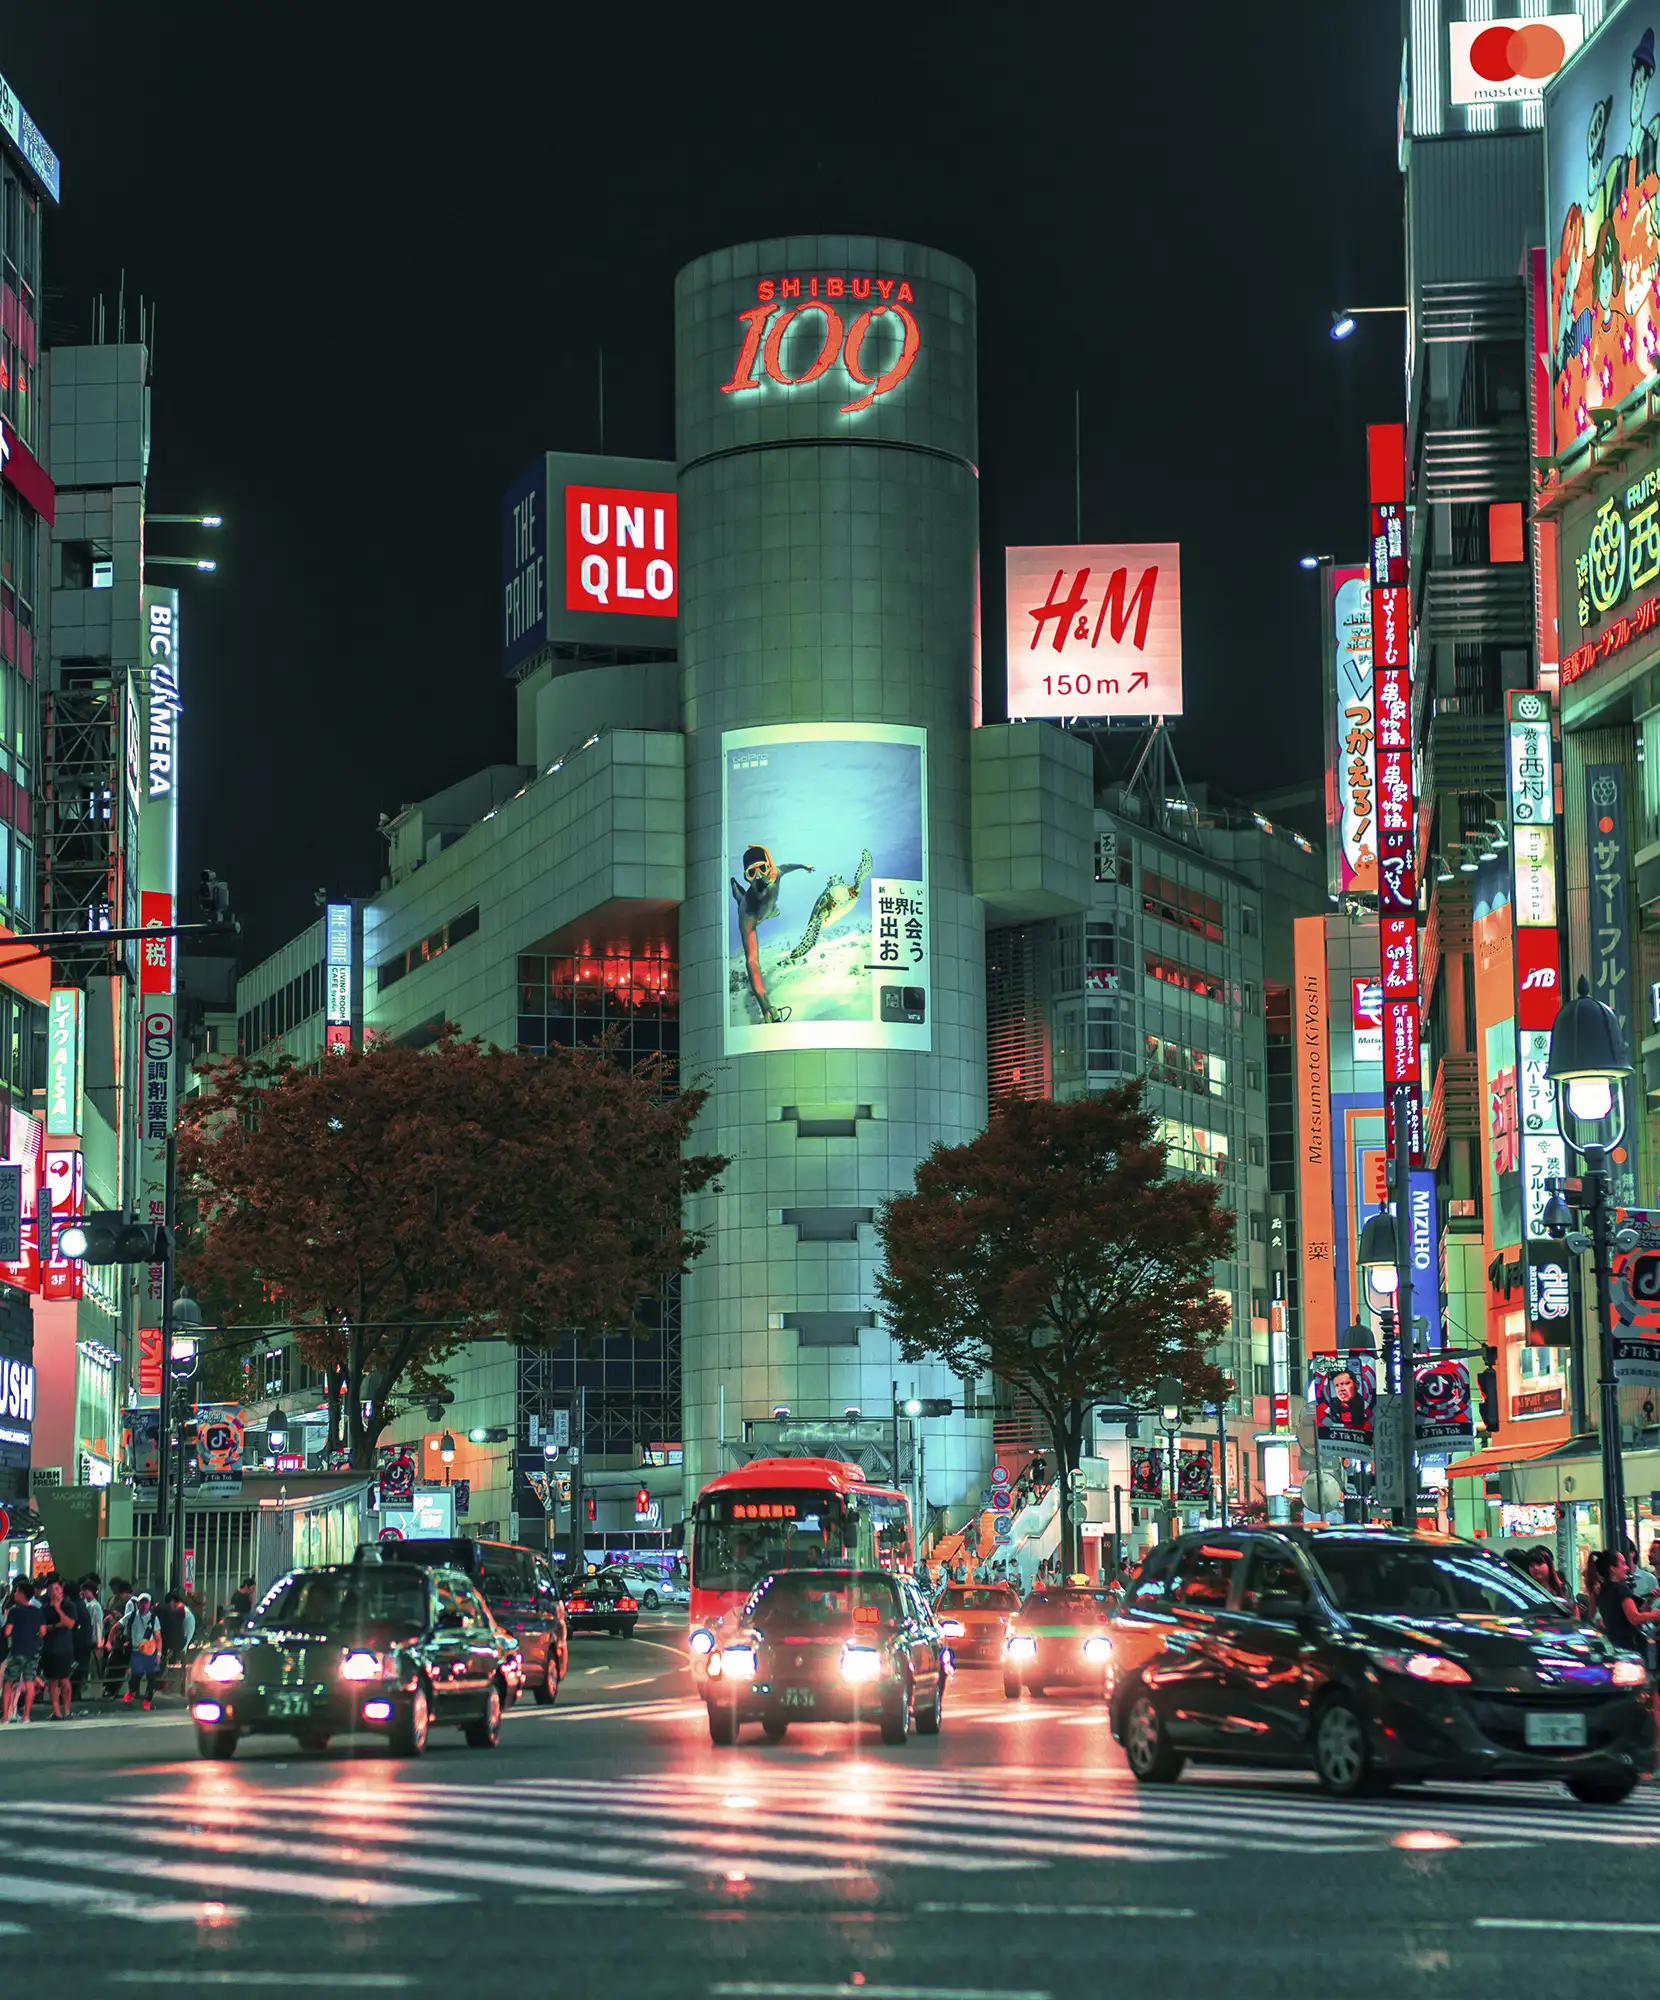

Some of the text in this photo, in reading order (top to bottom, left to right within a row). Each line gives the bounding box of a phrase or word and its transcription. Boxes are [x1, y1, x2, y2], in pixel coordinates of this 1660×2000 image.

[757, 277, 914, 303] SHIBUYA
[720, 300, 920, 414] 109
[513, 491, 535, 568] THE
[580, 503, 665, 550] UNI
[1380, 506, 1395, 517] 8F
[580, 555, 673, 604] QLO
[1383, 588, 1397, 599] 8F
[1576, 553, 1590, 628] 渋谷
[505, 556, 544, 647] PRIME
[1029, 565, 1159, 653] H&M
[1385, 670, 1398, 680] 7F
[149, 604, 182, 796] BIC CAMERA
[733, 752, 769, 762] GoPro
[1387, 752, 1400, 762] 7F
[1519, 727, 1545, 801] 渋谷西村
[1388, 835, 1403, 846] 6F
[879, 897, 923, 916] 世界に
[332, 908, 347, 963] THE PRIME
[1391, 921, 1404, 932] 6F
[1522, 967, 1557, 989] JTB
[1393, 1005, 1408, 1016] 6F
[147, 1062, 168, 1140] 調剤薬局
[1308, 1051, 1323, 1164] Matsumoto
[1531, 1164, 1544, 1215] フルーツ
[0, 1172, 16, 1255] 渋谷駅前
[1412, 1190, 1431, 1270] MIZUHO
[1308, 1241, 1329, 1261] 薬
[51, 1274, 66, 1285] 3F
[1529, 1265, 1537, 1303] BRITISH
[1538, 1263, 1569, 1320] HUB
[33, 1471, 60, 1479] LUSH
[994, 1470, 1004, 1479] 30
[71, 1502, 92, 1510] AREA
